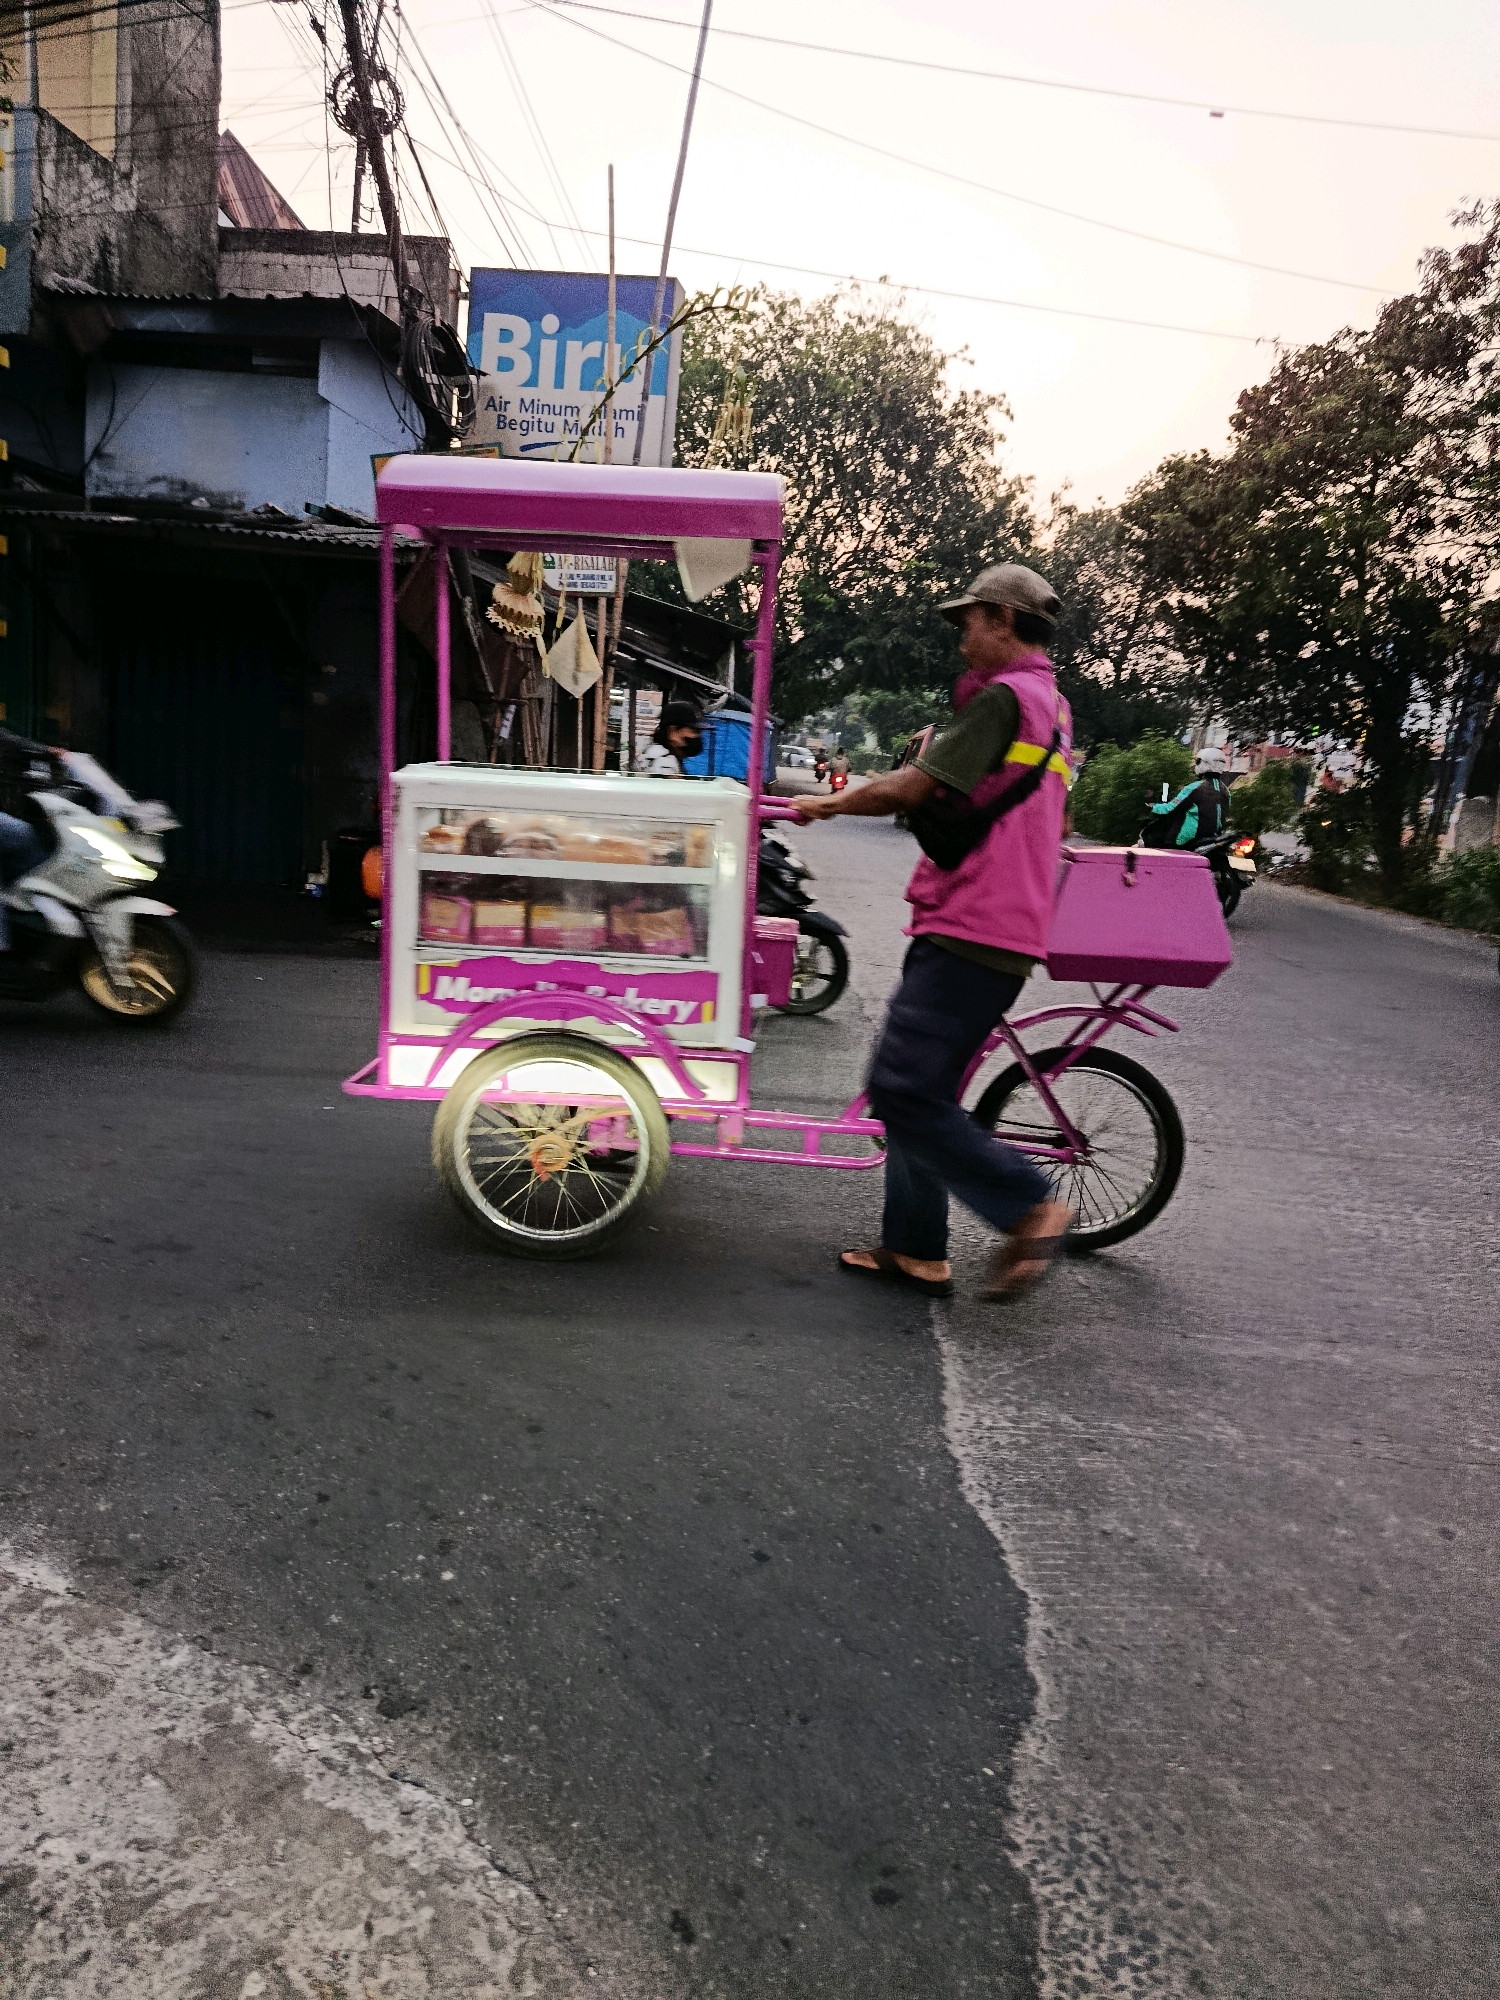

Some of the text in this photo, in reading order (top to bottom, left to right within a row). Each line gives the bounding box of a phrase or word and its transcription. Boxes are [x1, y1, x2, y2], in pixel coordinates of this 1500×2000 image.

[484, 395, 511, 412] Air
[519, 397, 580, 417] Minum
[496, 413, 555, 436] Begitu
